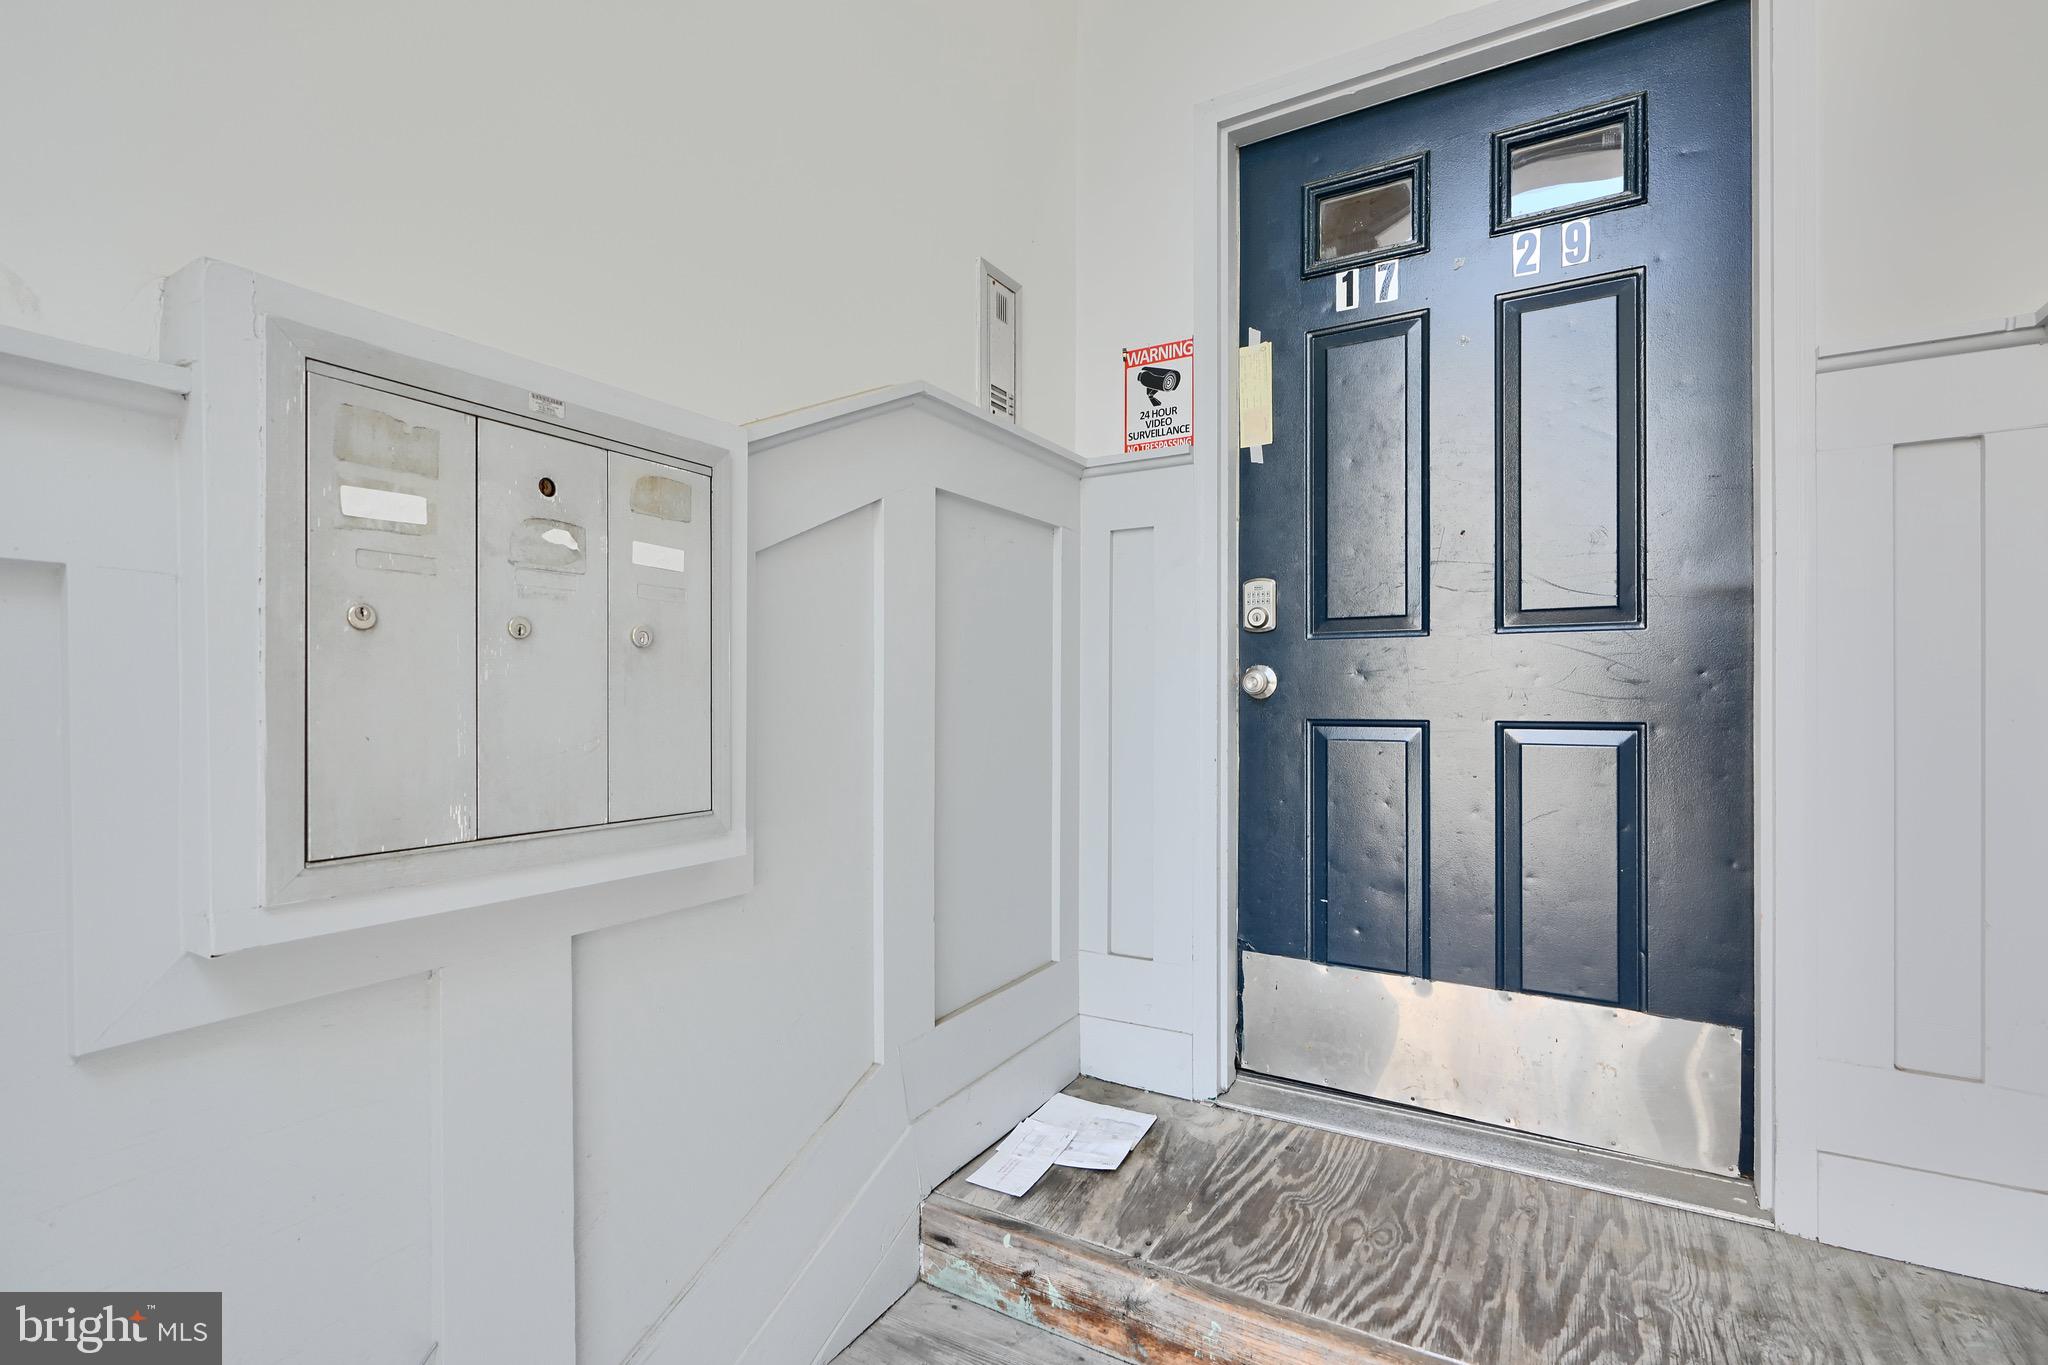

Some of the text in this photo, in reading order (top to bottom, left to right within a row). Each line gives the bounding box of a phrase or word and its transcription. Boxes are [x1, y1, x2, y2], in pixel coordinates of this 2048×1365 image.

[1127, 341, 1193, 366] WARNING
[1140, 406, 1178, 420] 24 HOUR
[1145, 416, 1173, 429] VIDEO
[1128, 424, 1190, 441] SURVEILLANCE
[1141, 438, 1191, 451] TRESPASSING
